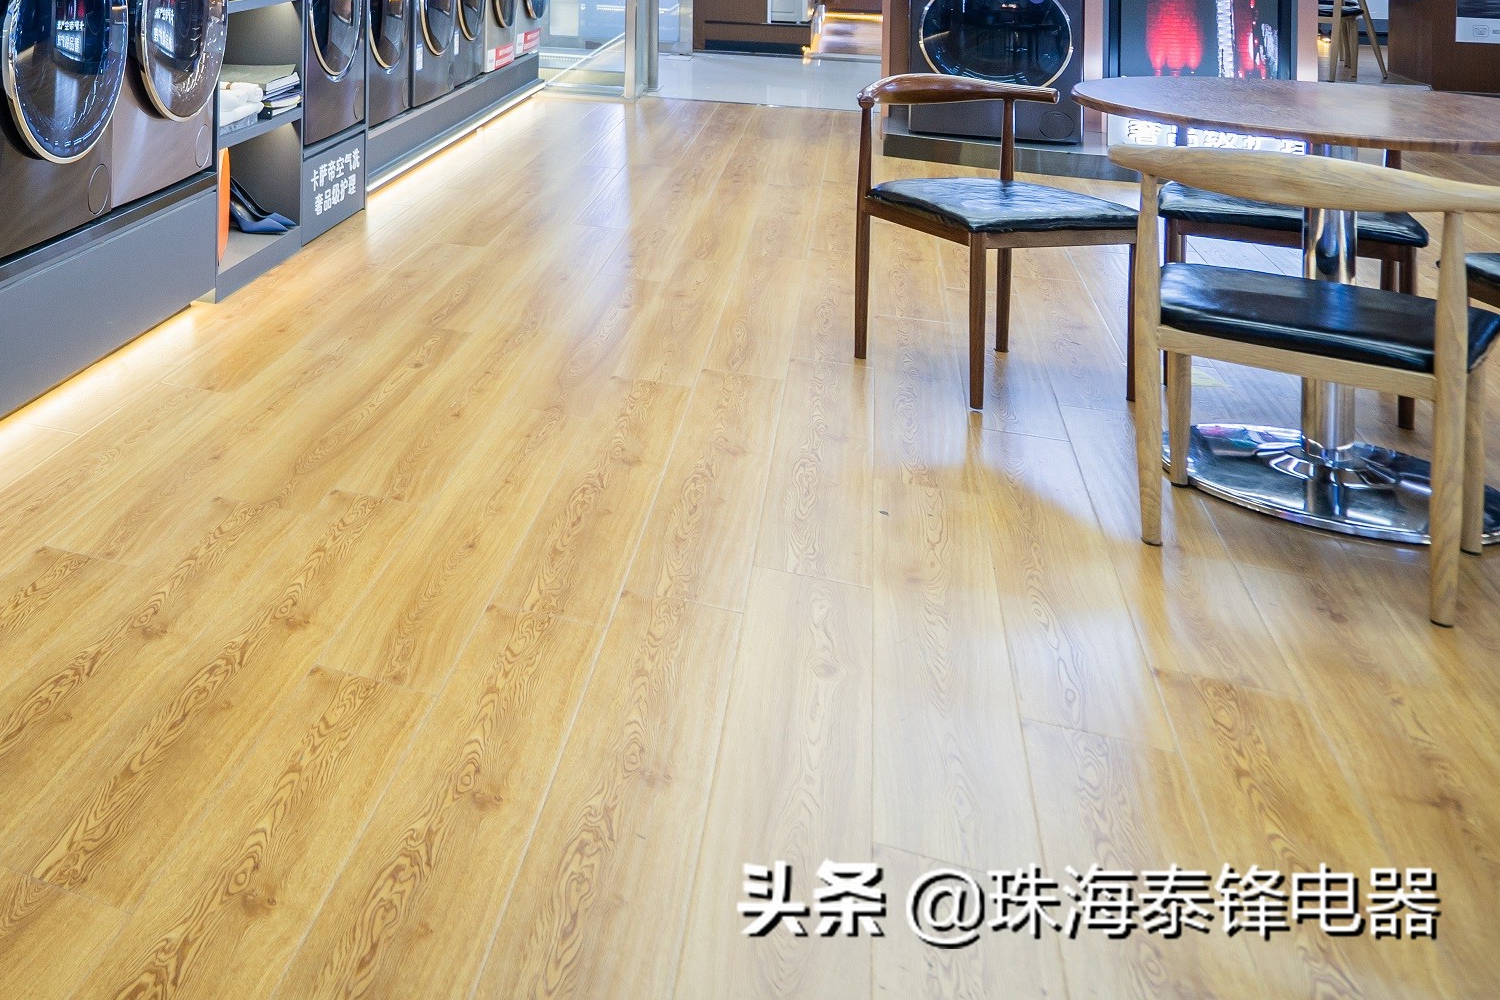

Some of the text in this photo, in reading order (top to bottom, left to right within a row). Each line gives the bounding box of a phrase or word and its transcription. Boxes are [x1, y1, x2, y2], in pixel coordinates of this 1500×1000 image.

[310, 147, 361, 192] 卡萨帝空气洗
[314, 173, 357, 216] 奢品级护理
